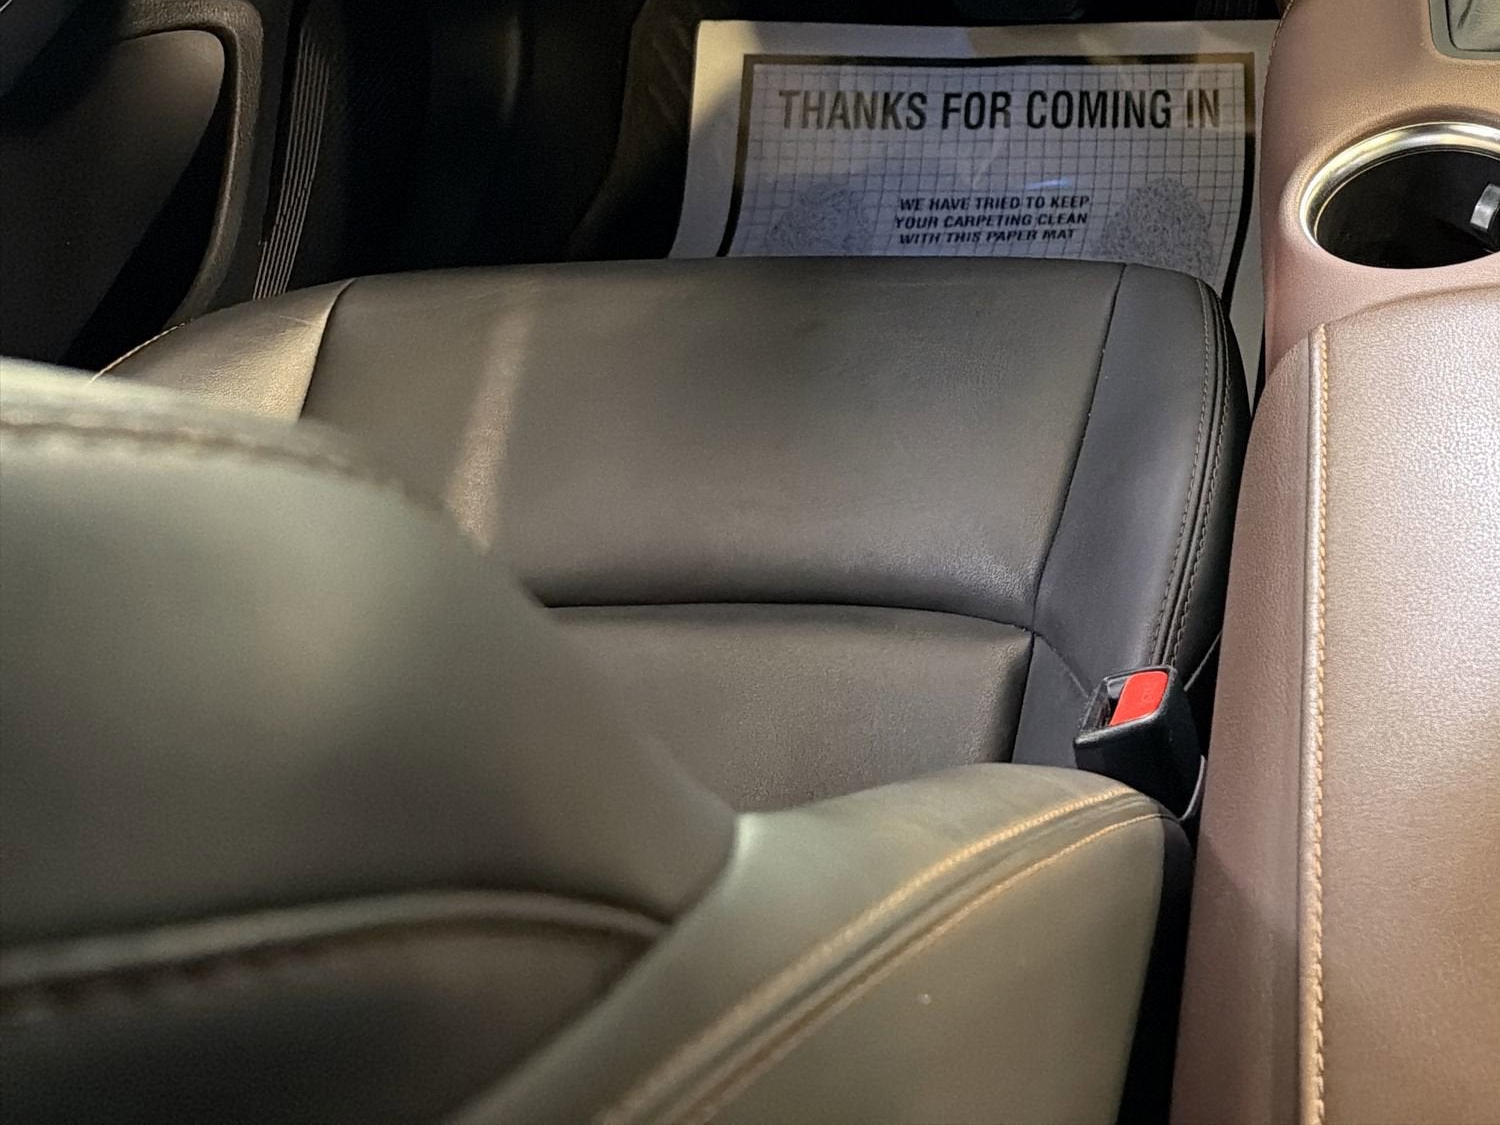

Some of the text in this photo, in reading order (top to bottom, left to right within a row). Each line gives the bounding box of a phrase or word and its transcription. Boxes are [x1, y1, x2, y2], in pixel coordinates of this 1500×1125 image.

[779, 88, 1221, 130] THANKS FOR COMING IN
[900, 196, 1090, 211] WE HAVE TRIED TO KEEP
[895, 213, 1088, 229] YOUR CARPETING CLEAN
[900, 229, 1076, 244] WITH THIS PAPER MAT
